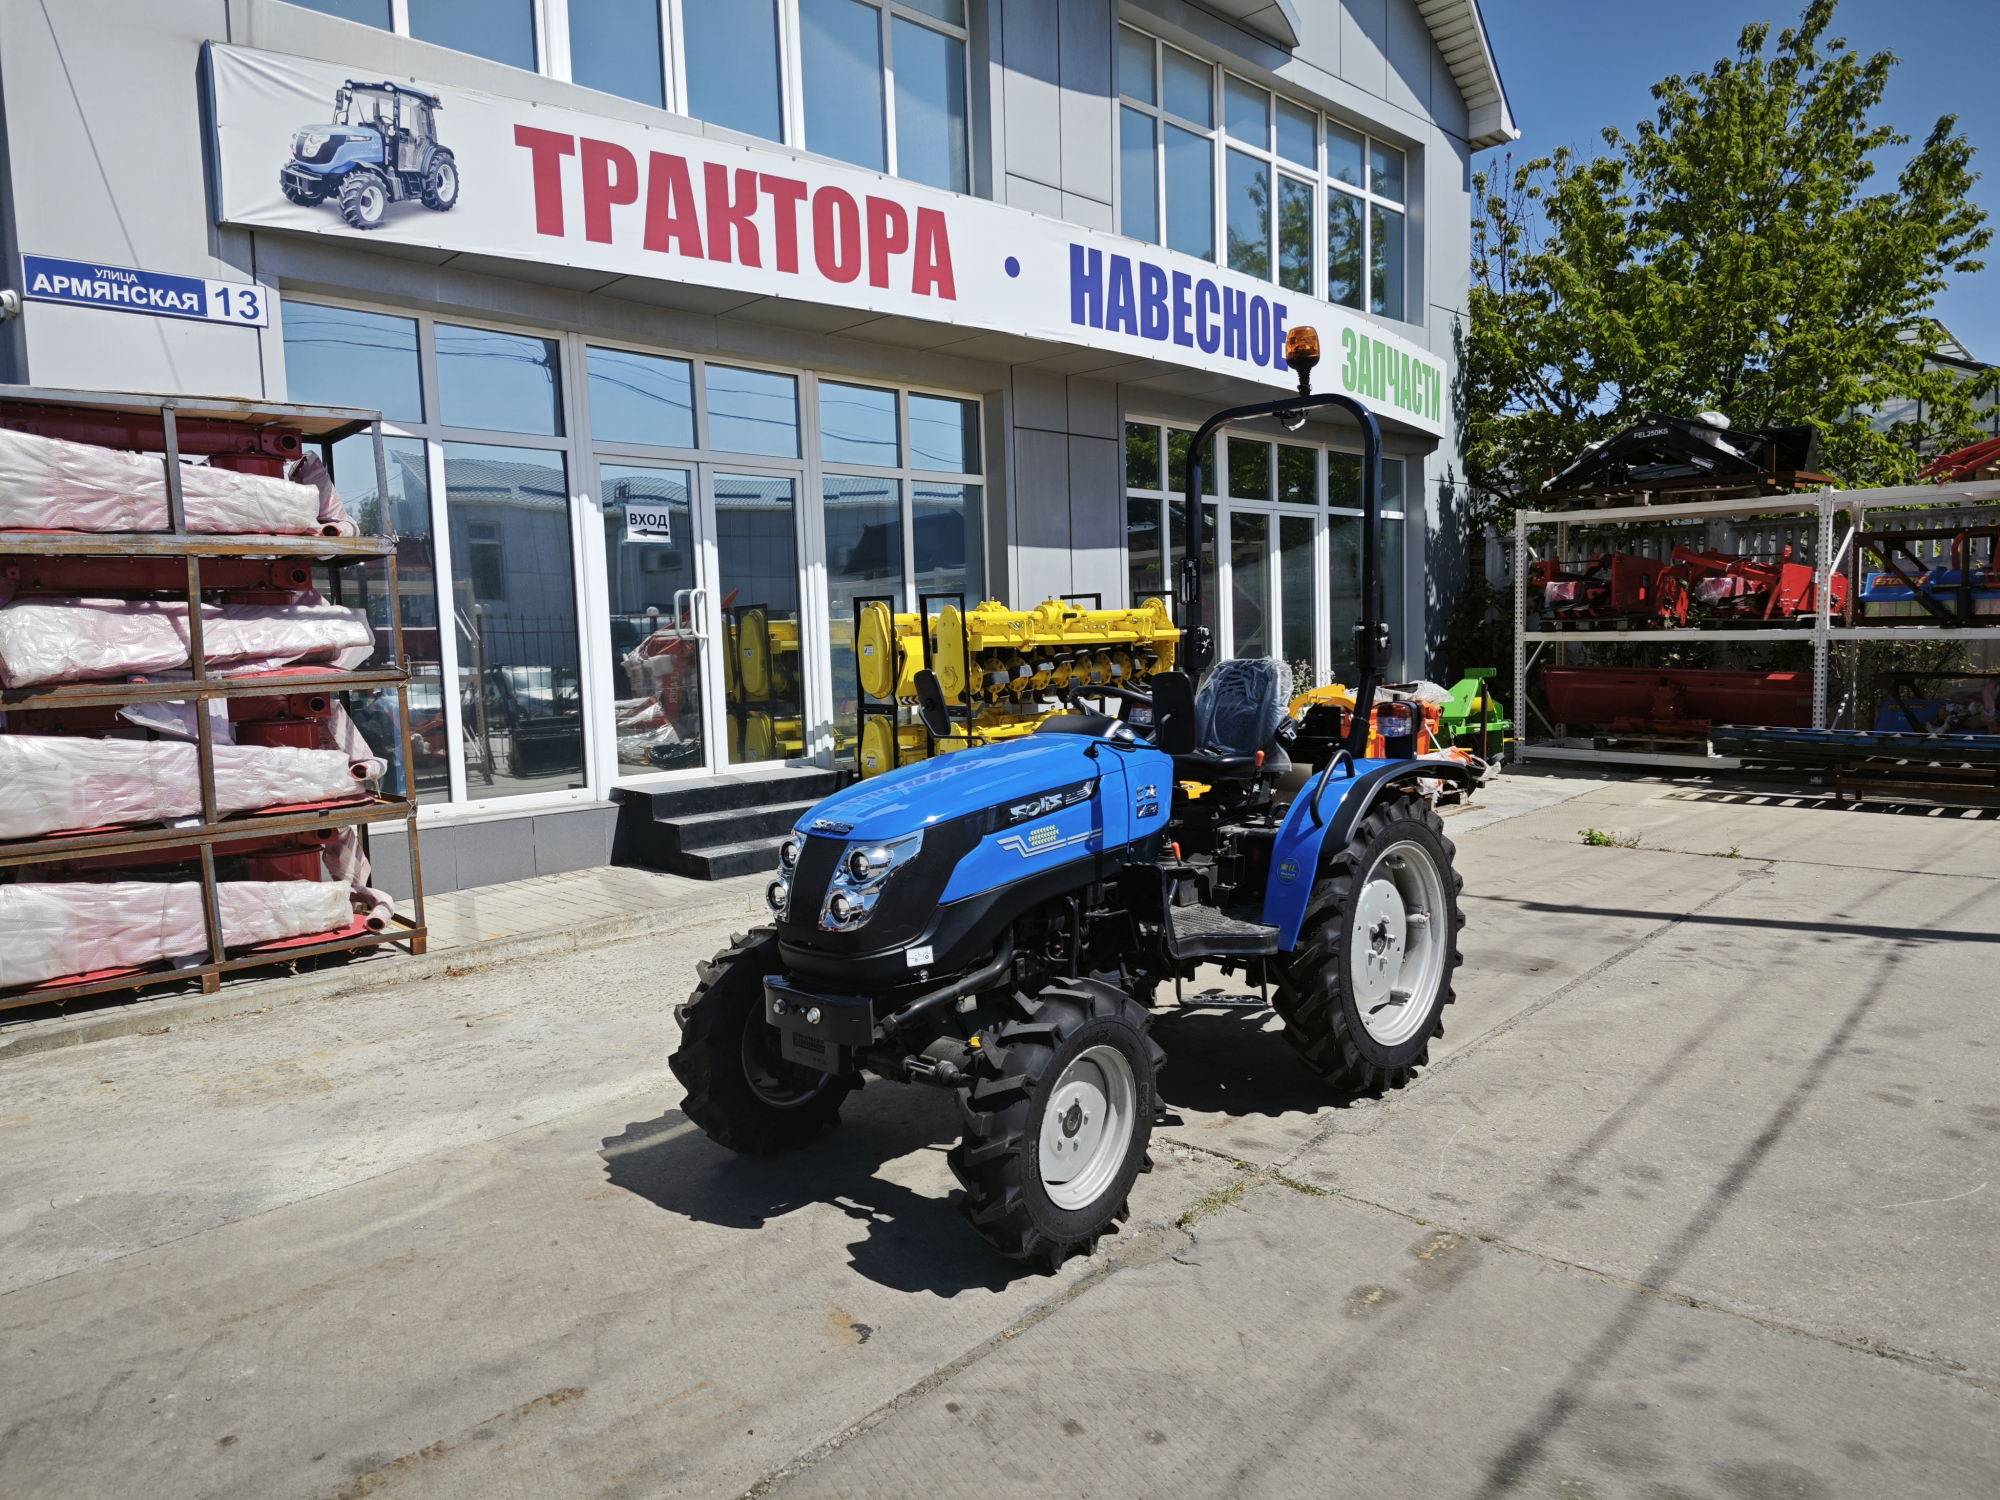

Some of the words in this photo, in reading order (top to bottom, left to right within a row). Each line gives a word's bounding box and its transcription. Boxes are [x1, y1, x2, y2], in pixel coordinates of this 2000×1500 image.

[94, 268, 138, 284] УЛИЦА
[514, 124, 957, 301] ТРАКТОРА
[1069, 242, 1289, 372] НАВЕСНОЕ
[1341, 327, 1441, 423] ЗАПЧАСТИ
[32, 273, 199, 311] АРМЯНСКАЯ
[214, 287, 260, 320] 13
[1633, 427, 1669, 439] FEL250KS
[629, 513, 668, 529] ВХОД
